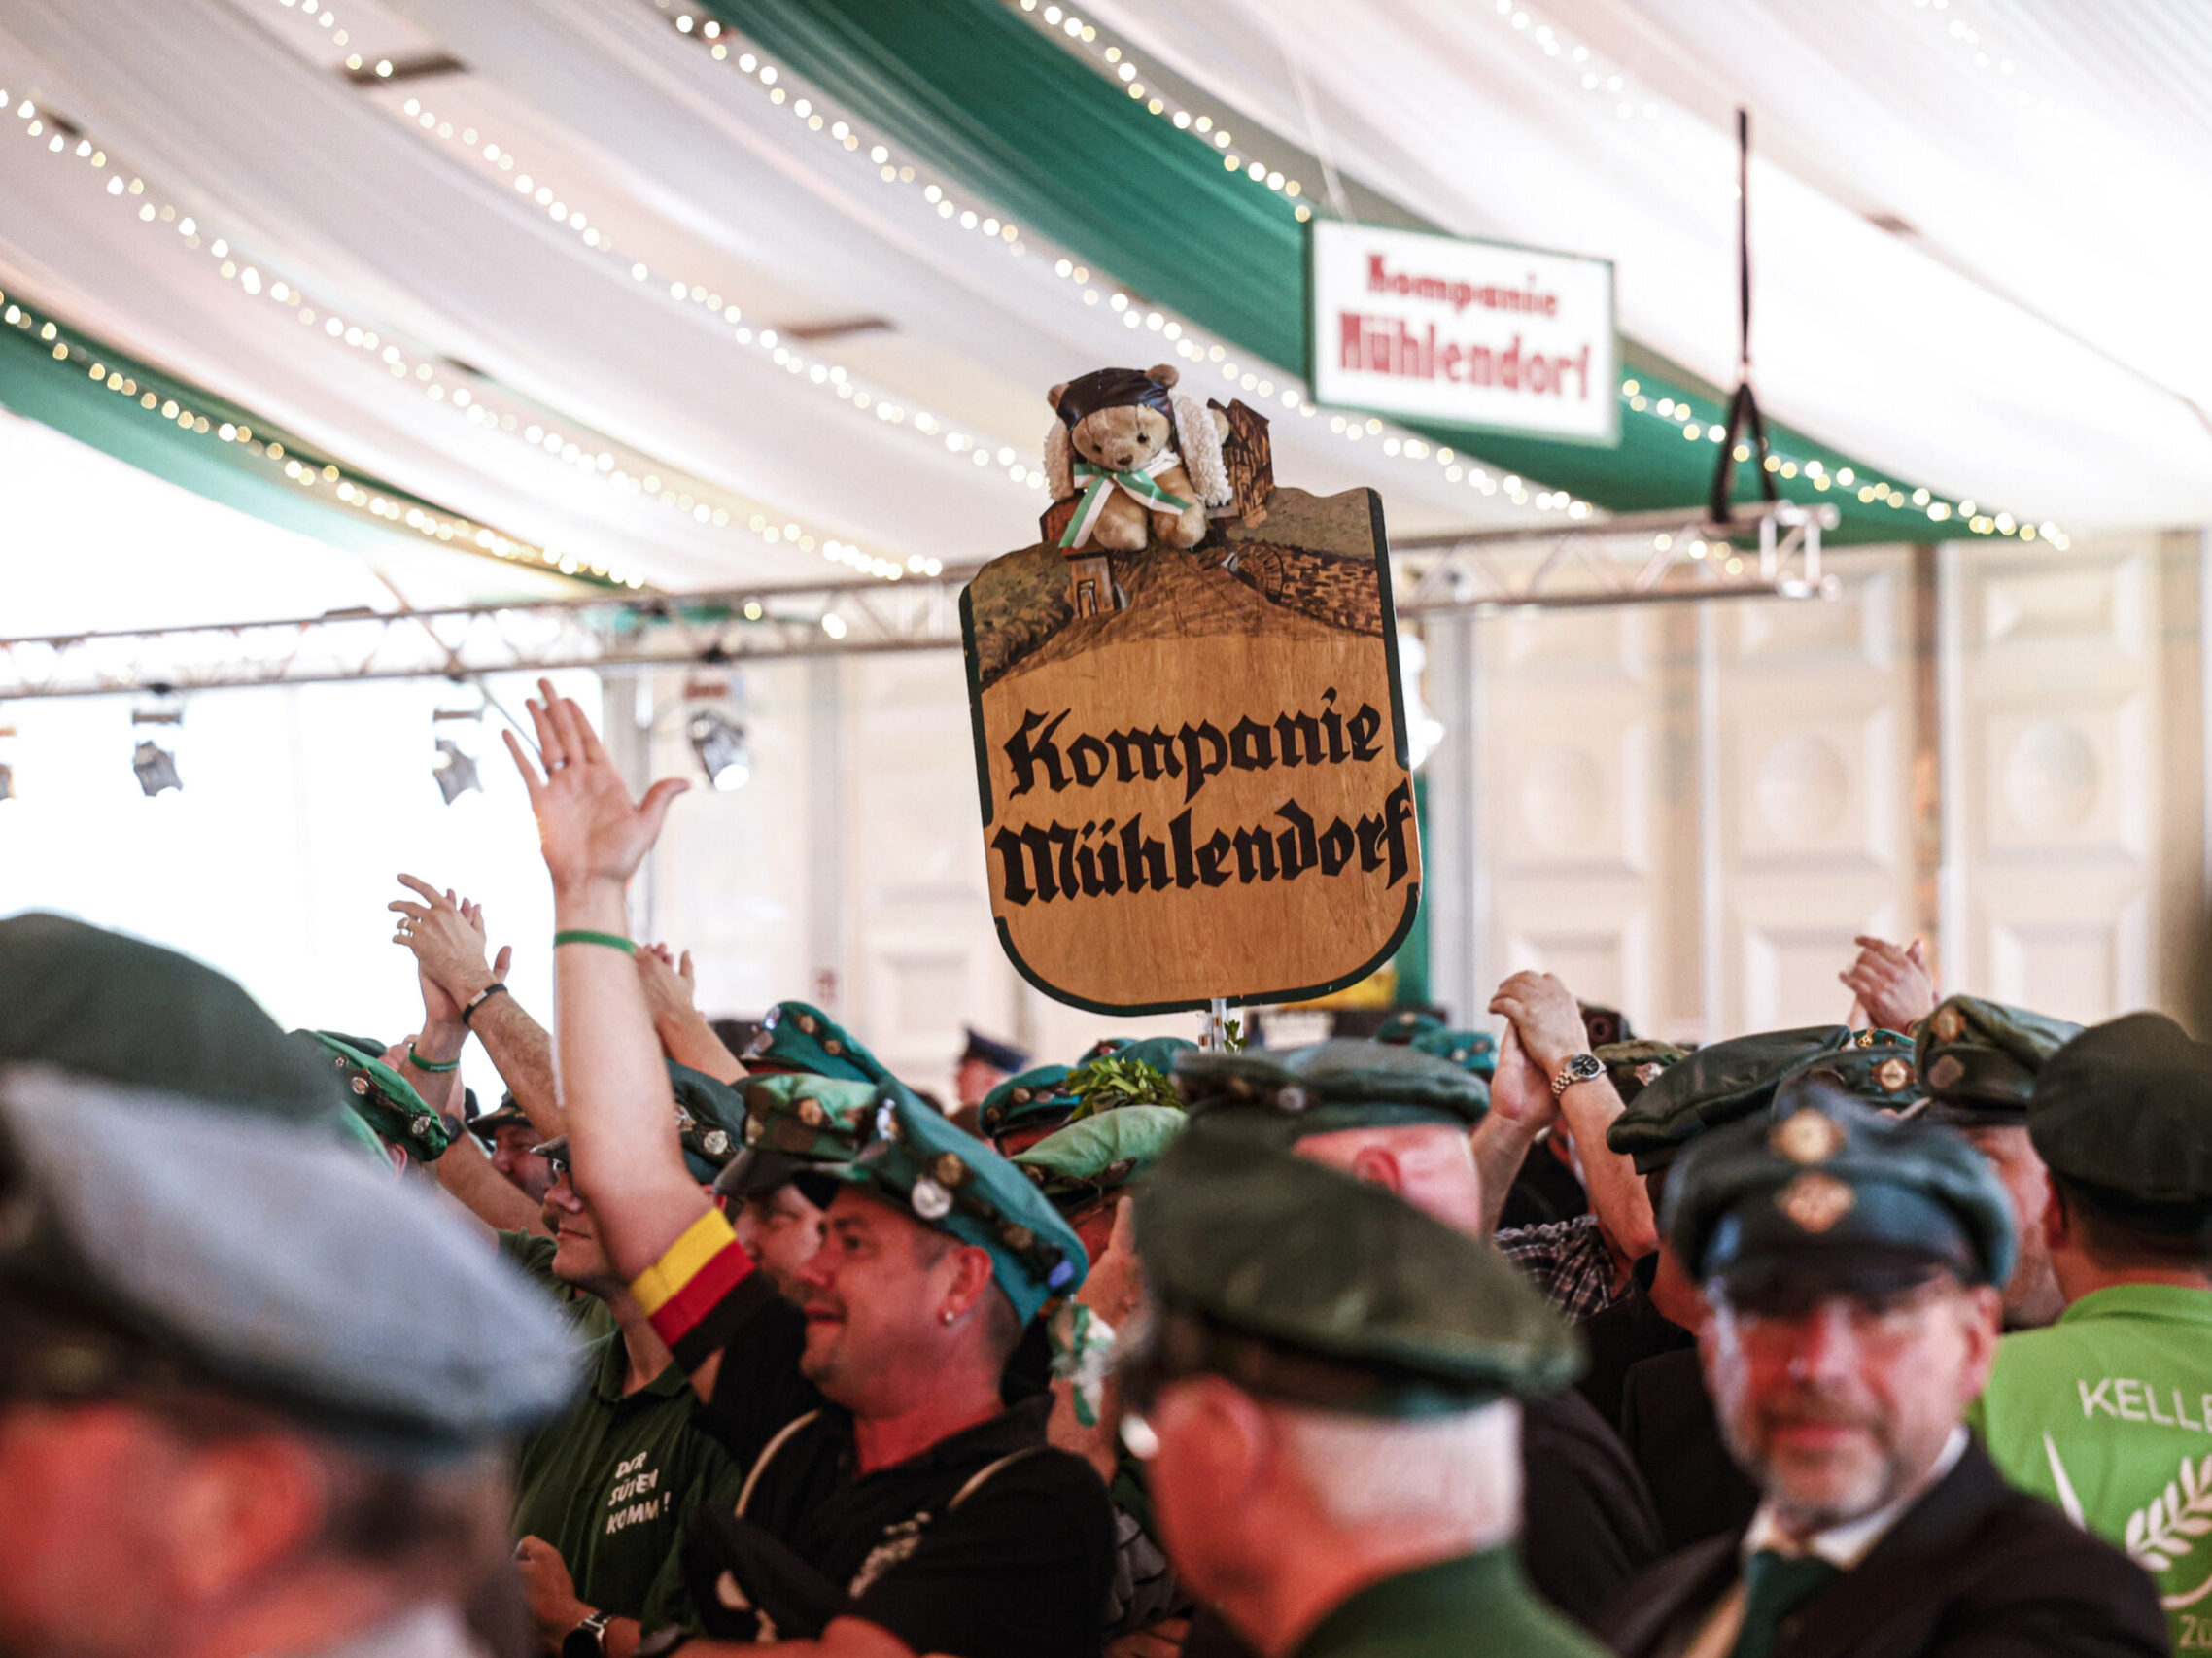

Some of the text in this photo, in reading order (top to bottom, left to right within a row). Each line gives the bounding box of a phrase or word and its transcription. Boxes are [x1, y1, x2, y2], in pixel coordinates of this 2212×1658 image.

[1366, 251, 1559, 318] Kompanie
[1338, 309, 1590, 400] Mühlendorf
[1003, 686, 1383, 804] Kompanie
[991, 777, 1412, 906] Mühlendorf
